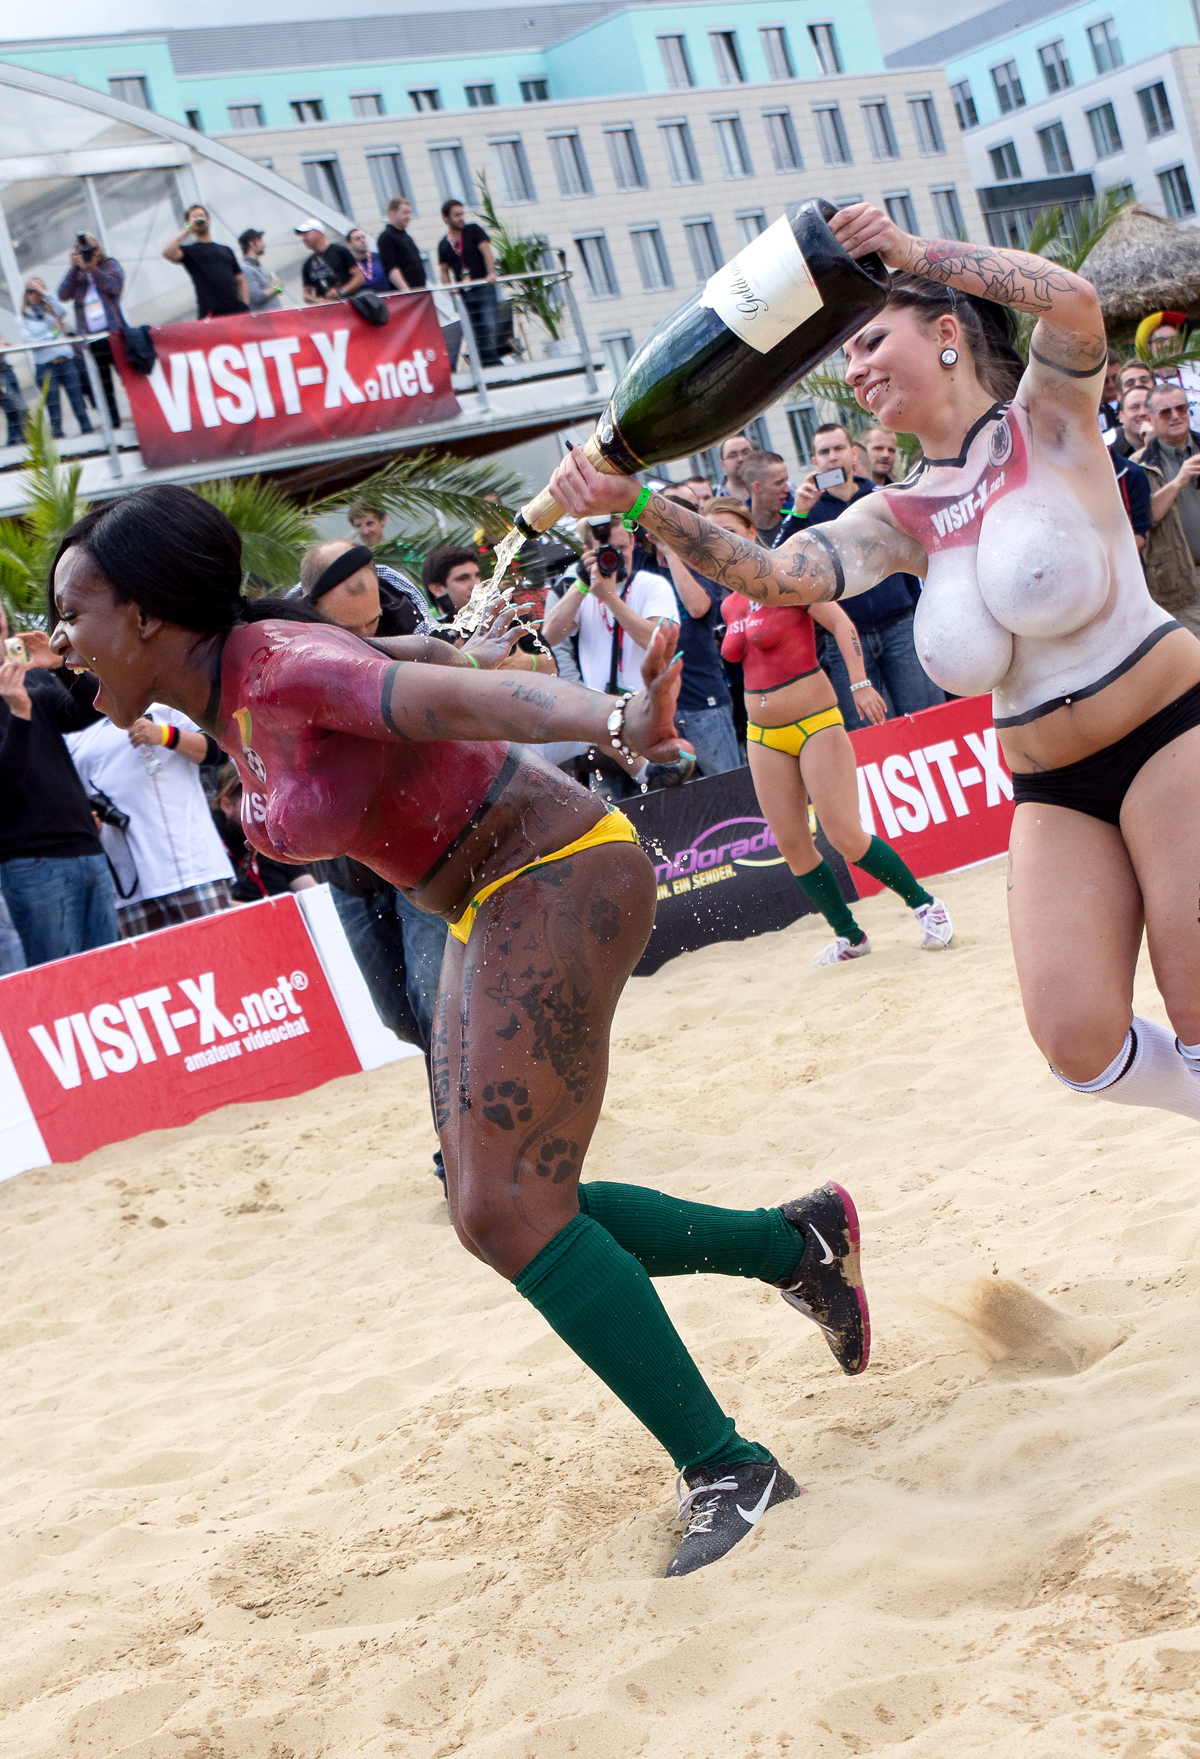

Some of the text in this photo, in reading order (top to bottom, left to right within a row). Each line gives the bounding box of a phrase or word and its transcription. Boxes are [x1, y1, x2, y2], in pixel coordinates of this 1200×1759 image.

[672, 876, 692, 895] EIN
[692, 864, 738, 889] SENDER.
[184, 1015, 311, 1072] amateur videochat
